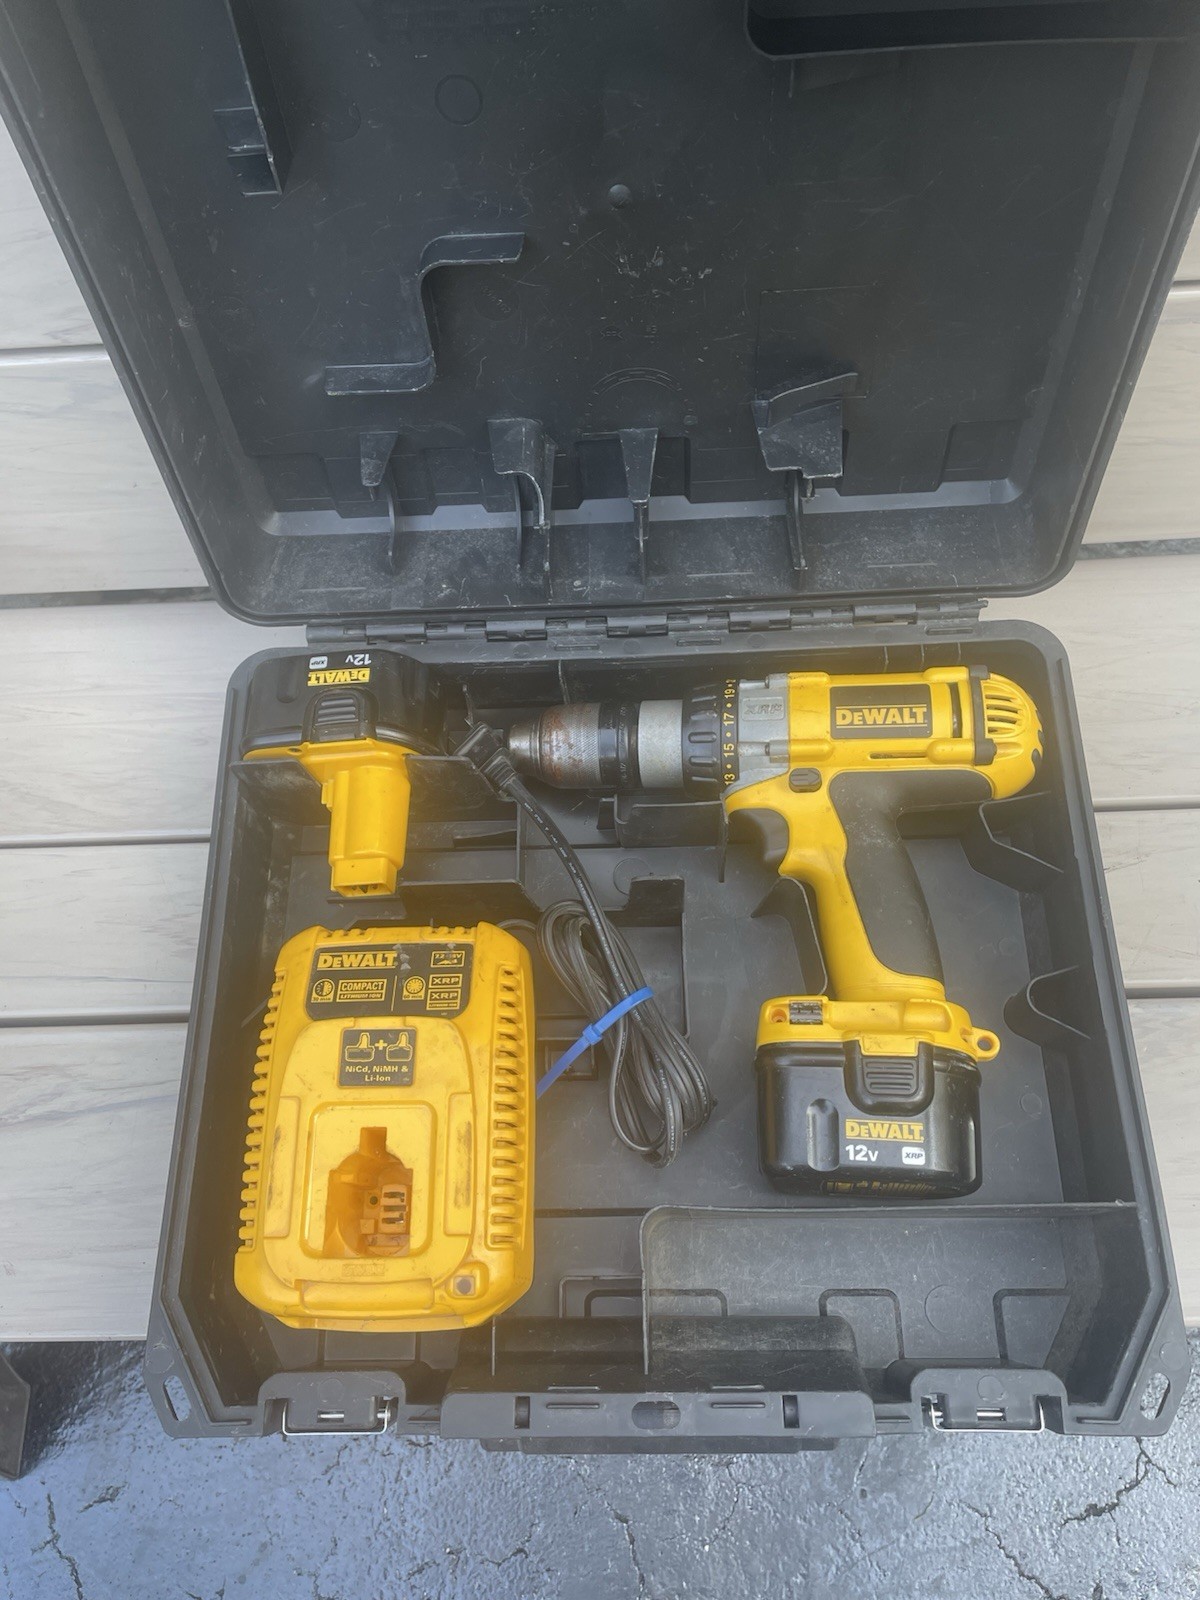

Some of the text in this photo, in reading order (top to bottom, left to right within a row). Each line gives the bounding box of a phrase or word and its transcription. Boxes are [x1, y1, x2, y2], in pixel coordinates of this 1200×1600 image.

[724, 688, 736, 699] 19
[744, 703, 783, 715] XRP
[723, 712, 735, 726] 17
[723, 743, 735, 758] 15
[724, 773, 736, 785] 13
[341, 982, 384, 991] COMPACT
[432, 977, 459, 985] XRP
[345, 1065, 371, 1073] NiCd,
[904, 1151, 924, 1160] XRP
